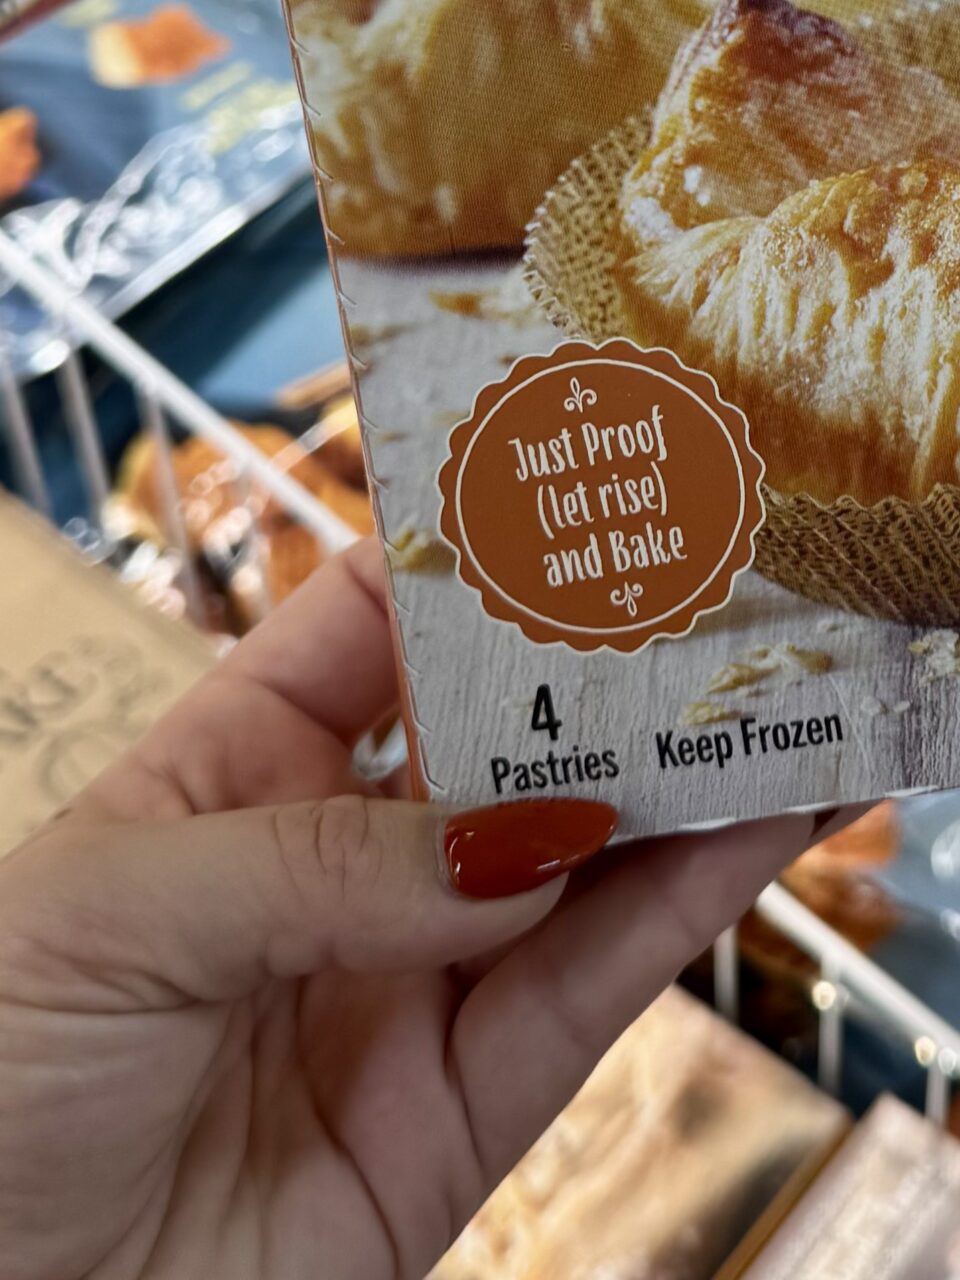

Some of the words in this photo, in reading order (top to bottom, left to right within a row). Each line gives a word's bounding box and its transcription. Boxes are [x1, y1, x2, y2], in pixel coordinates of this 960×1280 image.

[509, 428, 581, 481] Just
[583, 405, 668, 465] Proof
[537, 482, 594, 539] (let
[598, 462, 668, 516] rise)
[543, 536, 603, 588] and
[610, 522, 688, 573] Bake
[532, 684, 562, 741] 4
[656, 729, 733, 769] Keep
[740, 713, 843, 757] Frozen
[491, 747, 619, 795] Pastries
